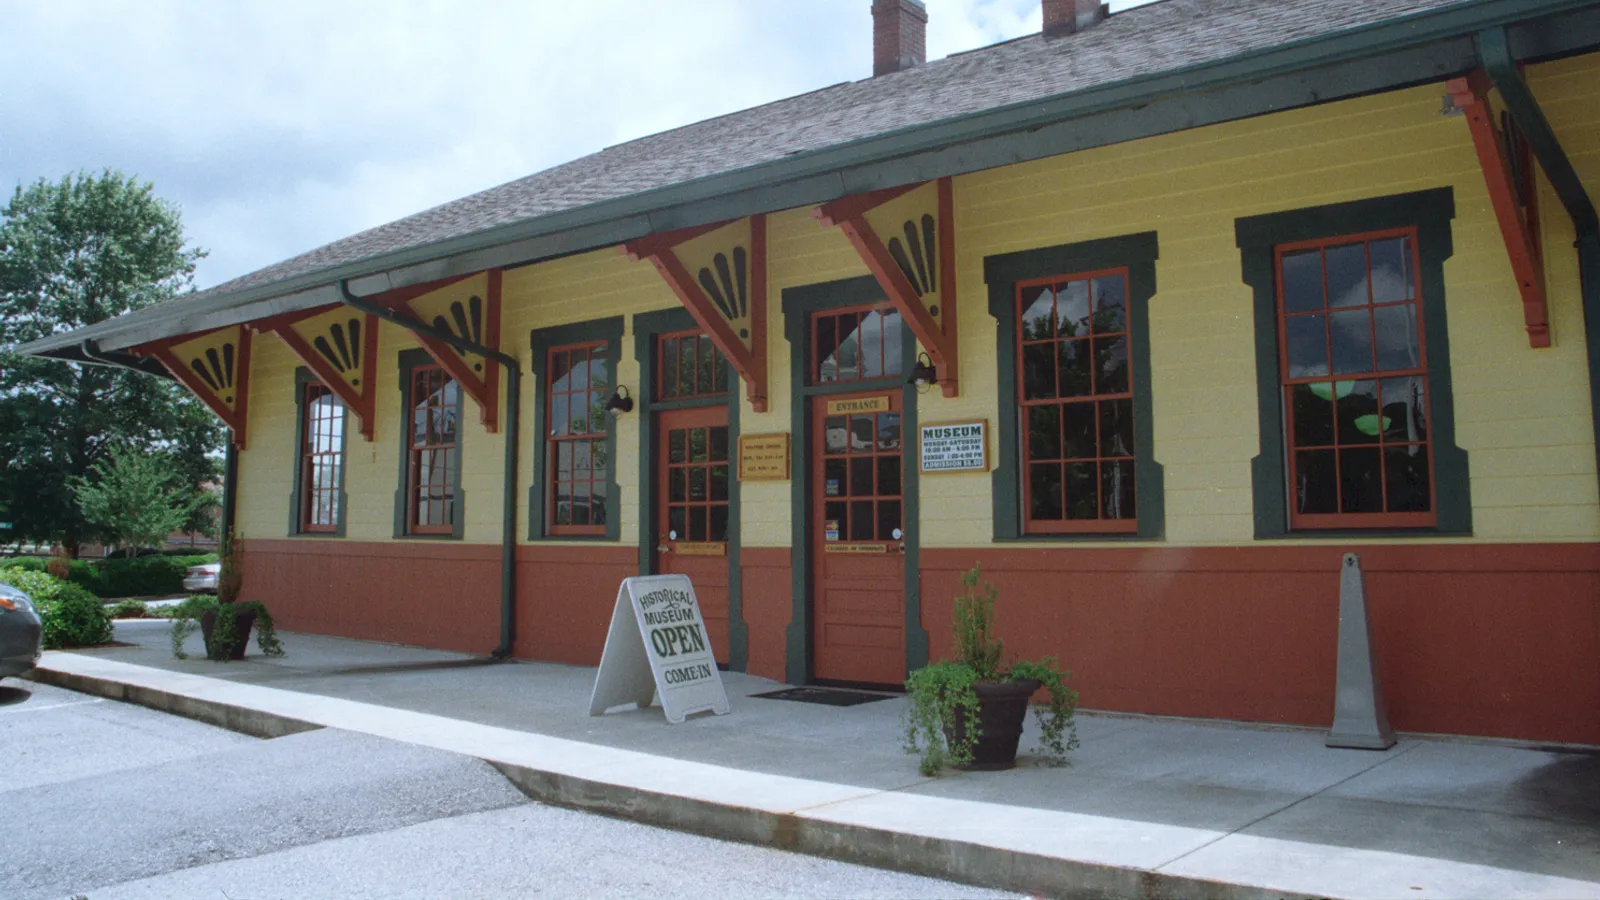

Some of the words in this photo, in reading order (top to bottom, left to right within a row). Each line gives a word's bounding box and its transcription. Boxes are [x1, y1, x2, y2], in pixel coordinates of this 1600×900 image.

[836, 399, 879, 411] ENTRANCE
[923, 426, 982, 439] MUSEUM
[924, 460, 961, 469] ADMISSION
[639, 588, 694, 611] HISTORICAL
[643, 608, 695, 625] MUSEUM
[651, 623, 706, 658] OPEN
